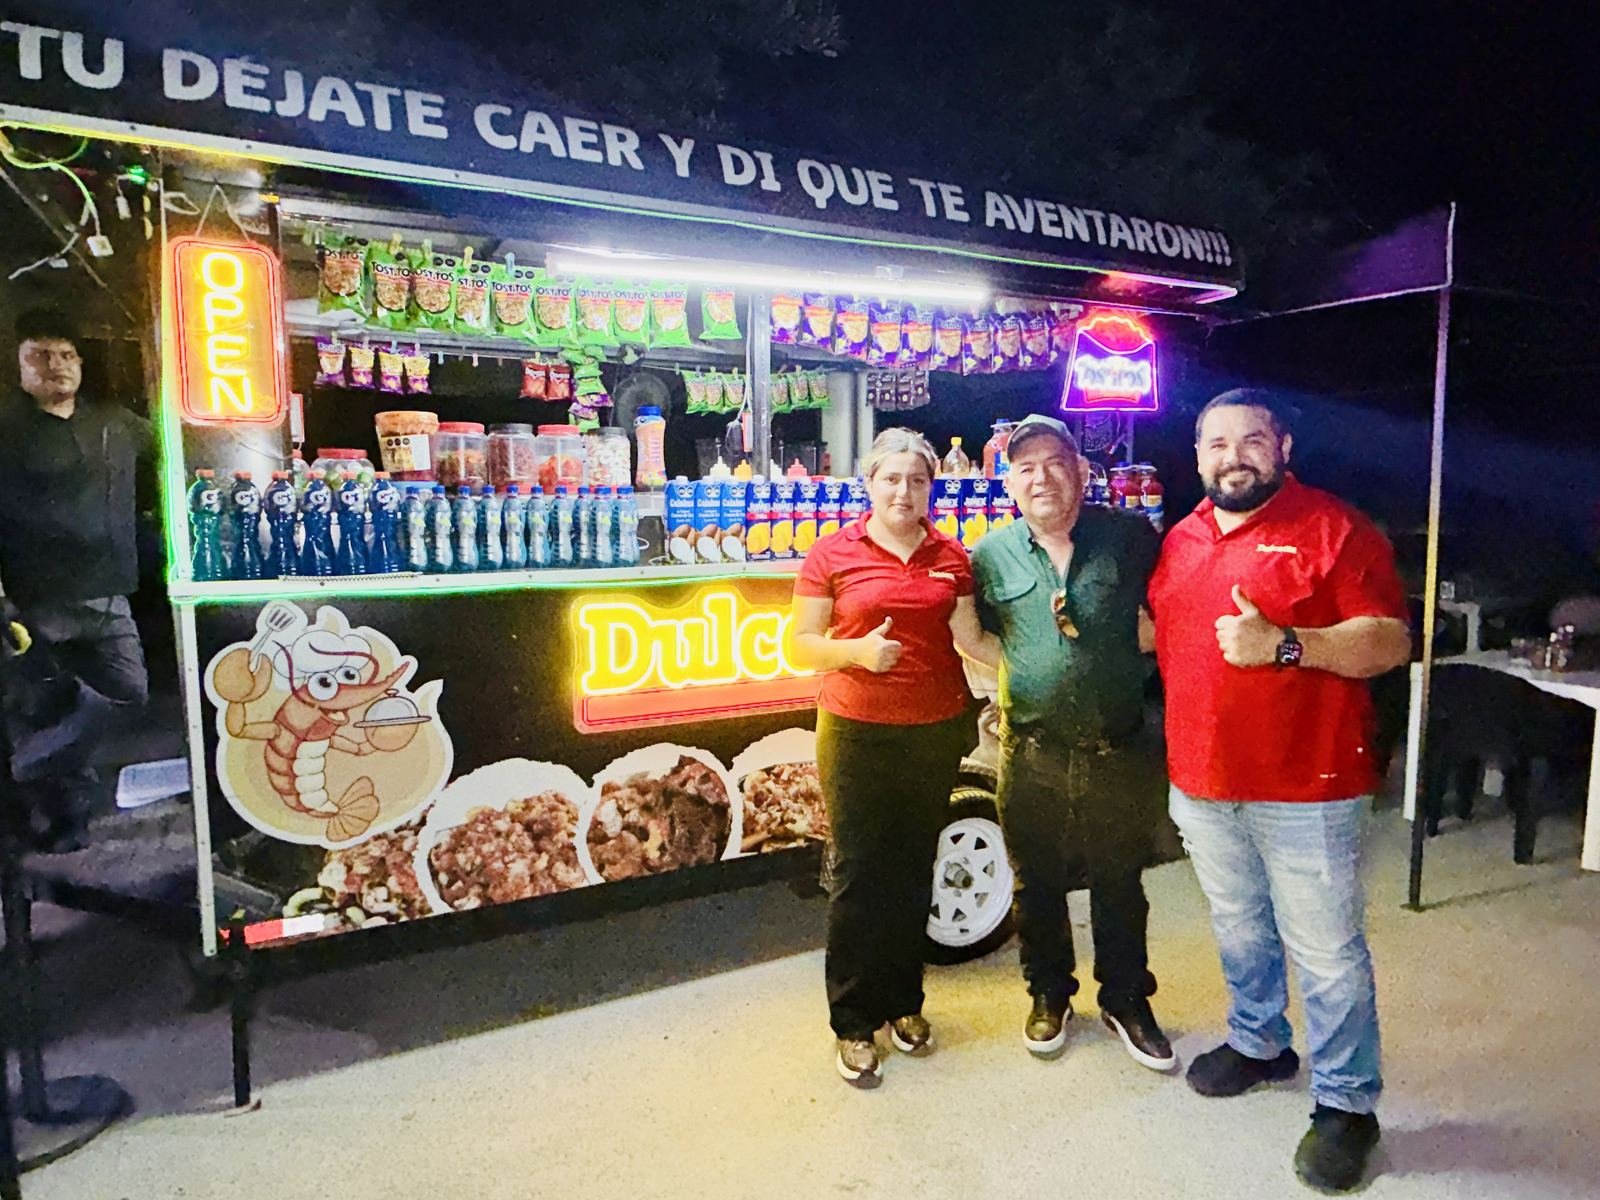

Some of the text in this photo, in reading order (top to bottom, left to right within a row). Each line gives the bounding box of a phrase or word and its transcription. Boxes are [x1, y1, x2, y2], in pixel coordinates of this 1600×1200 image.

[1, 22, 124, 90] TU
[473, 105, 645, 171] CAER
[658, 133, 695, 178] Y
[717, 144, 782, 192] DI
[798, 160, 899, 211] QUE
[908, 178, 970, 222] TE
[985, 191, 1233, 266] AVENTARON!!!
[200, 250, 252, 416] OPEN
